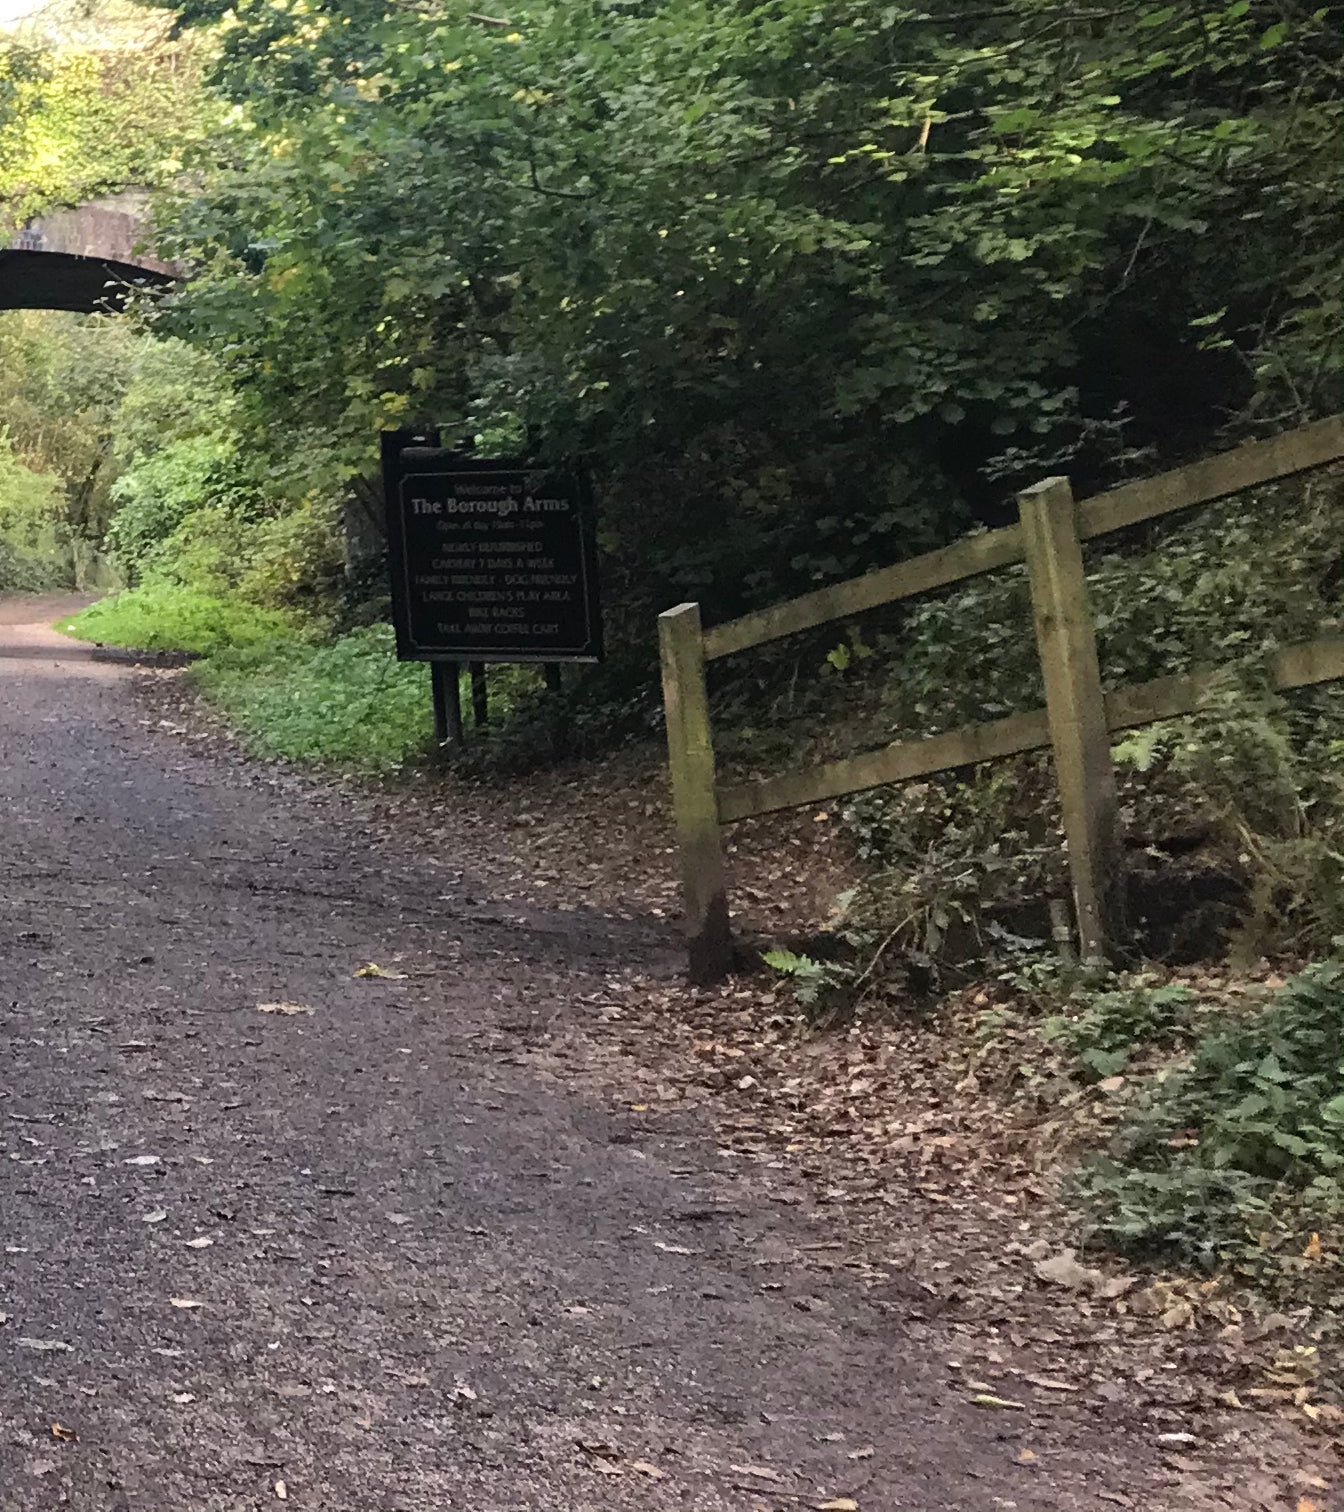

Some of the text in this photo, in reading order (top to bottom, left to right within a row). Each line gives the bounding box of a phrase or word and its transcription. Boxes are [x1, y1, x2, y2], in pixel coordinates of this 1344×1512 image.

[453, 483, 522, 495] Welcome to
[410, 496, 570, 517] The Borough Arms
